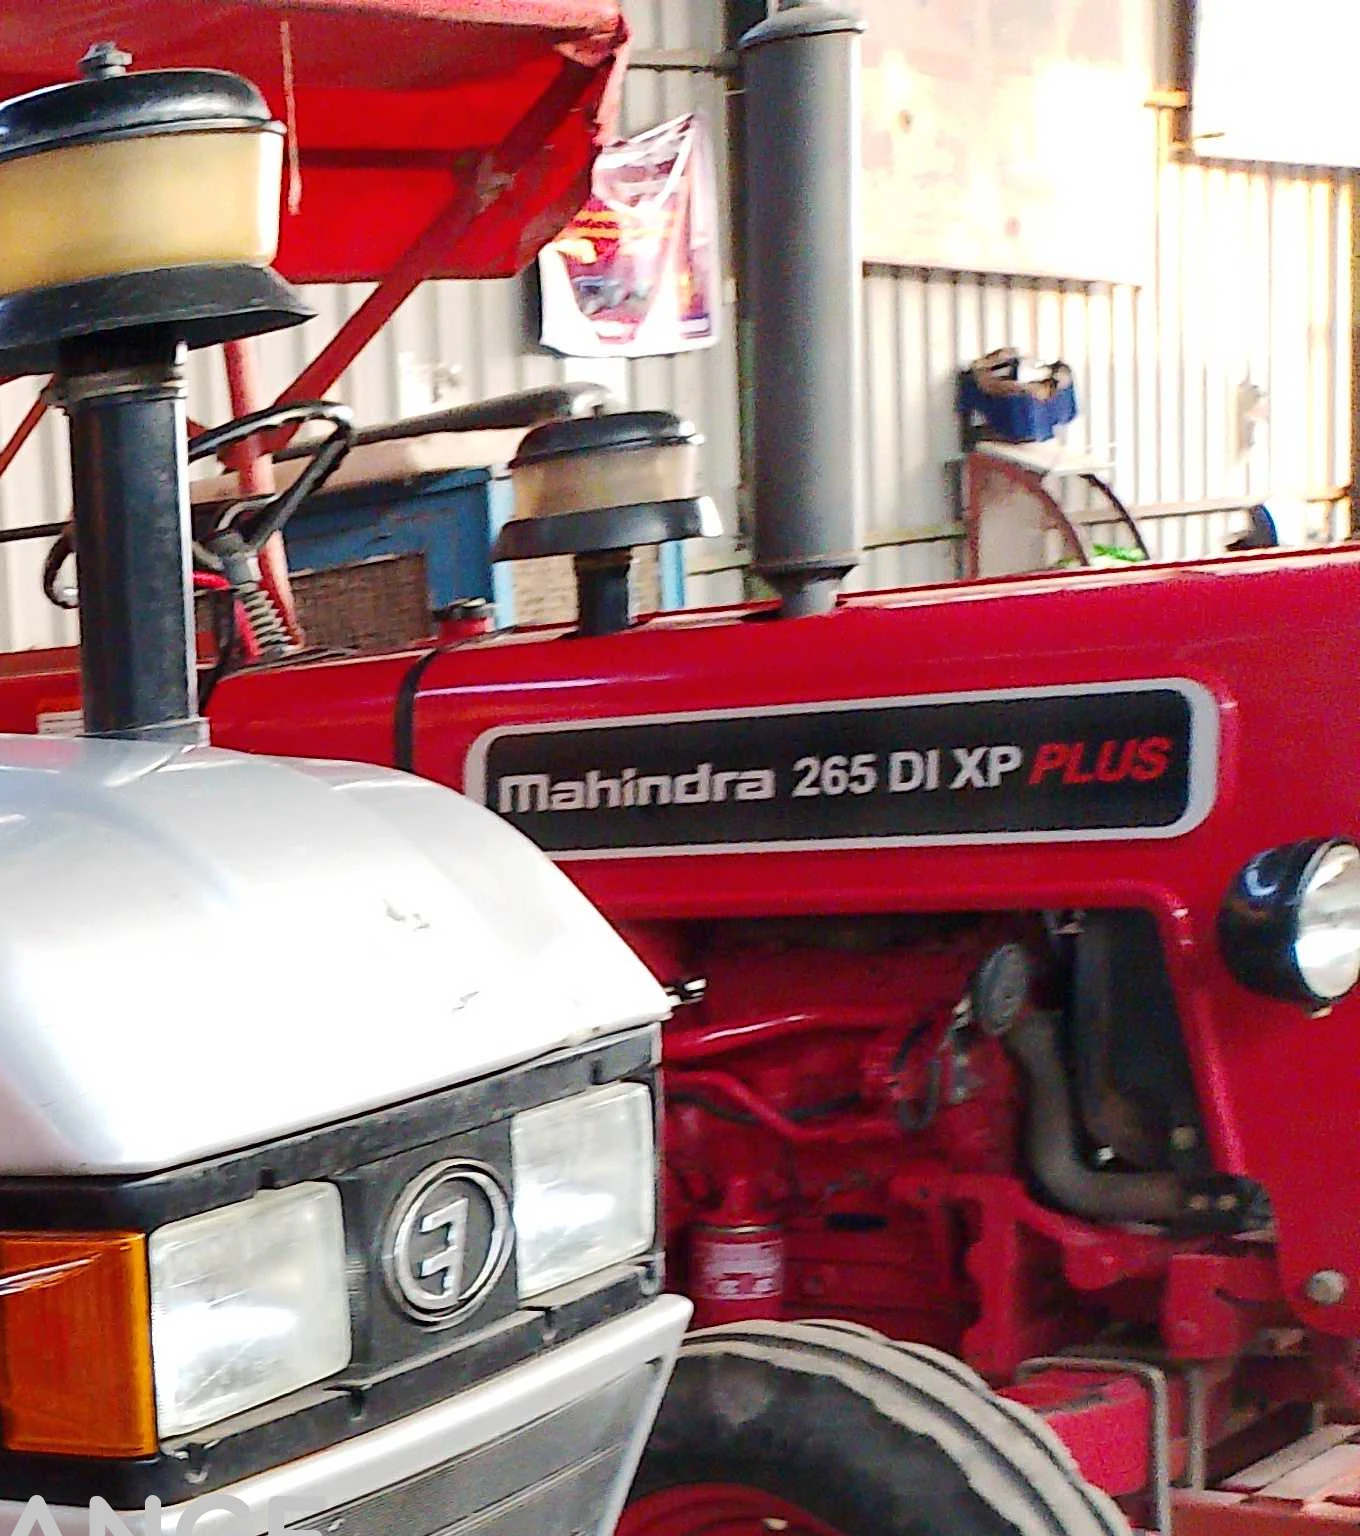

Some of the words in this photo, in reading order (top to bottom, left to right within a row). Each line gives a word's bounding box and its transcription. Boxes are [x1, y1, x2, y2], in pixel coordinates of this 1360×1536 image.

[497, 764, 775, 814] Mahindra
[791, 751, 880, 798] 265
[888, 750, 939, 794] DI
[951, 746, 1024, 790] XP
[1028, 736, 1175, 786] PLUS
